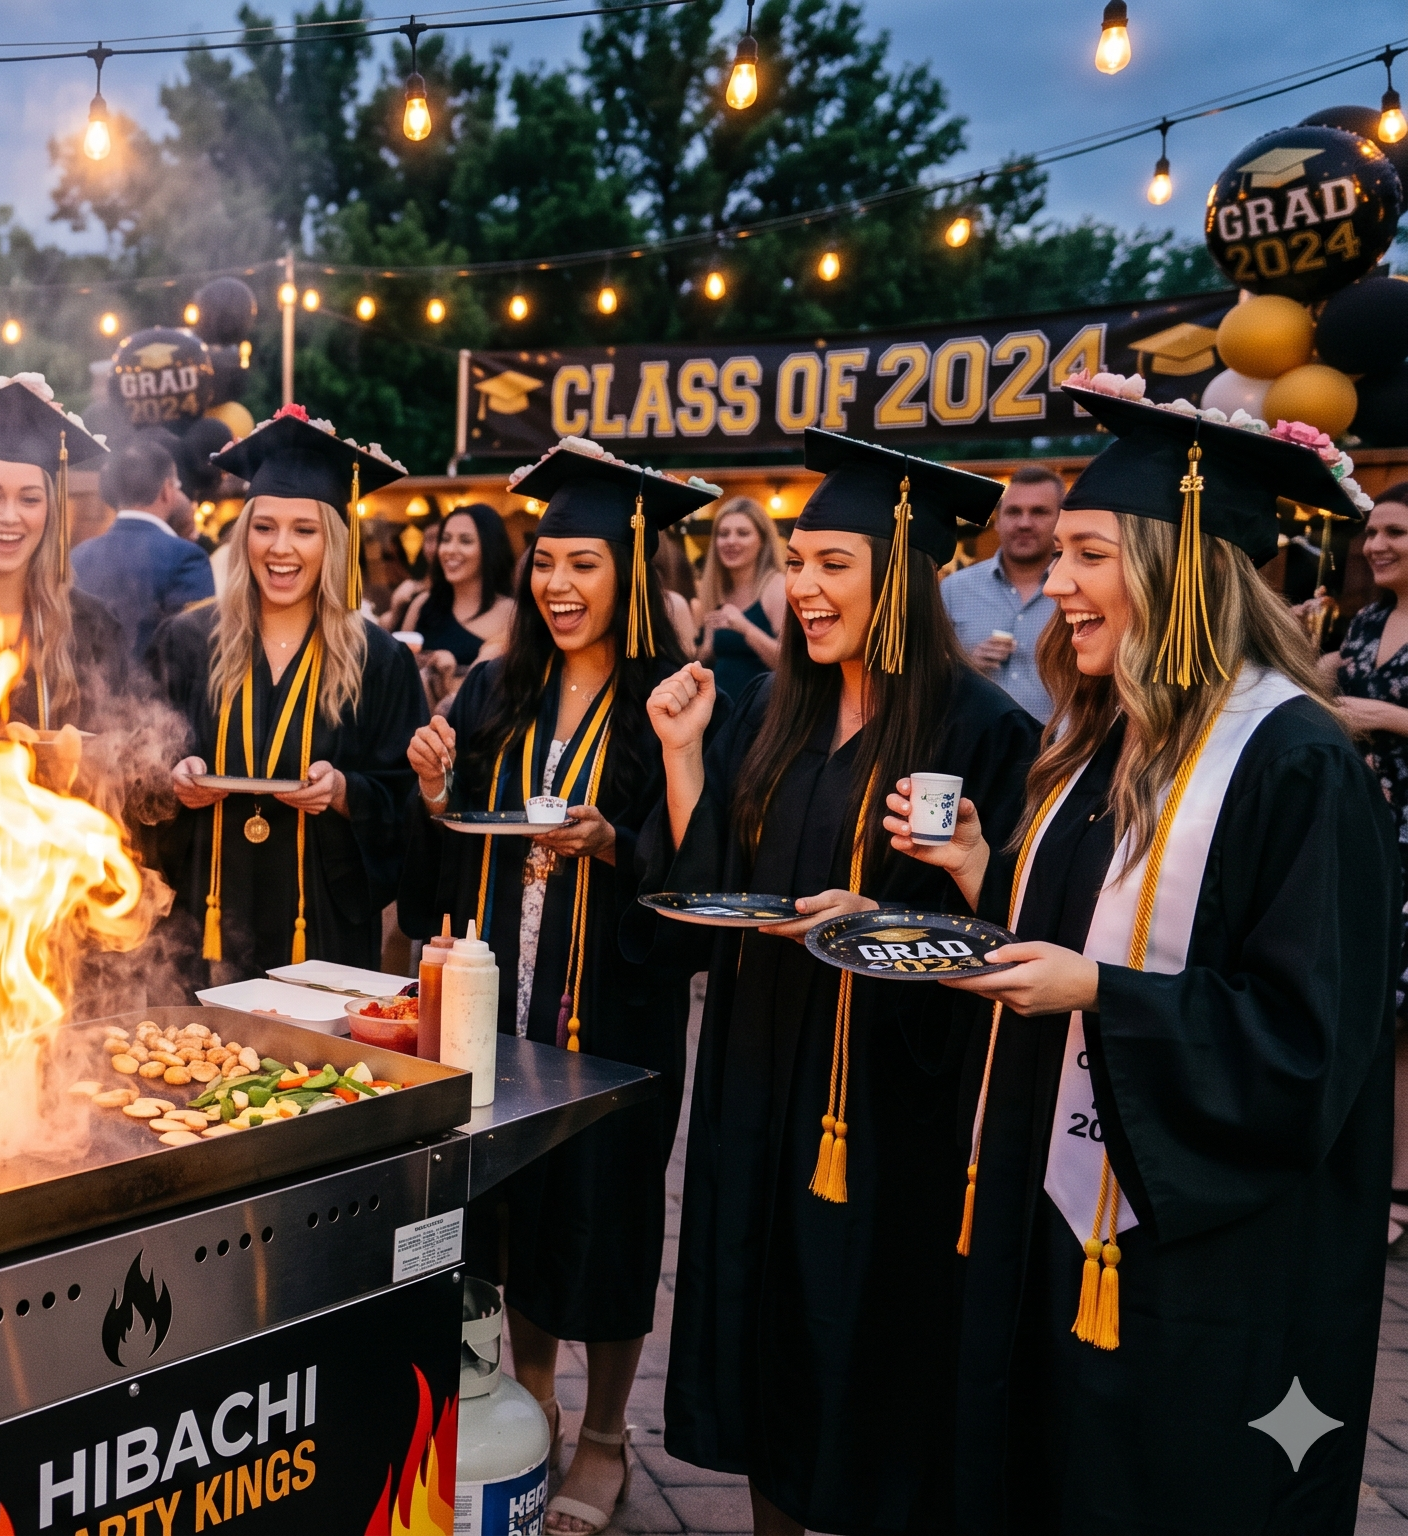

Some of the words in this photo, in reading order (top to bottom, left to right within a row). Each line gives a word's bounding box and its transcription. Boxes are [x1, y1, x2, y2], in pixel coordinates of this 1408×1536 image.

[1218, 177, 1359, 243] GRAD
[1224, 219, 1361, 282] 2024
[120, 366, 199, 399] GRAD
[123, 392, 199, 424] 2024
[551, 356, 763, 438] CLASS
[775, 348, 870, 434] OF
[874, 323, 1108, 429] 2024
[858, 940, 973, 961] GRAD
[39, 1364, 317, 1530] HIBACHI
[195, 1438, 317, 1533] KINGS
